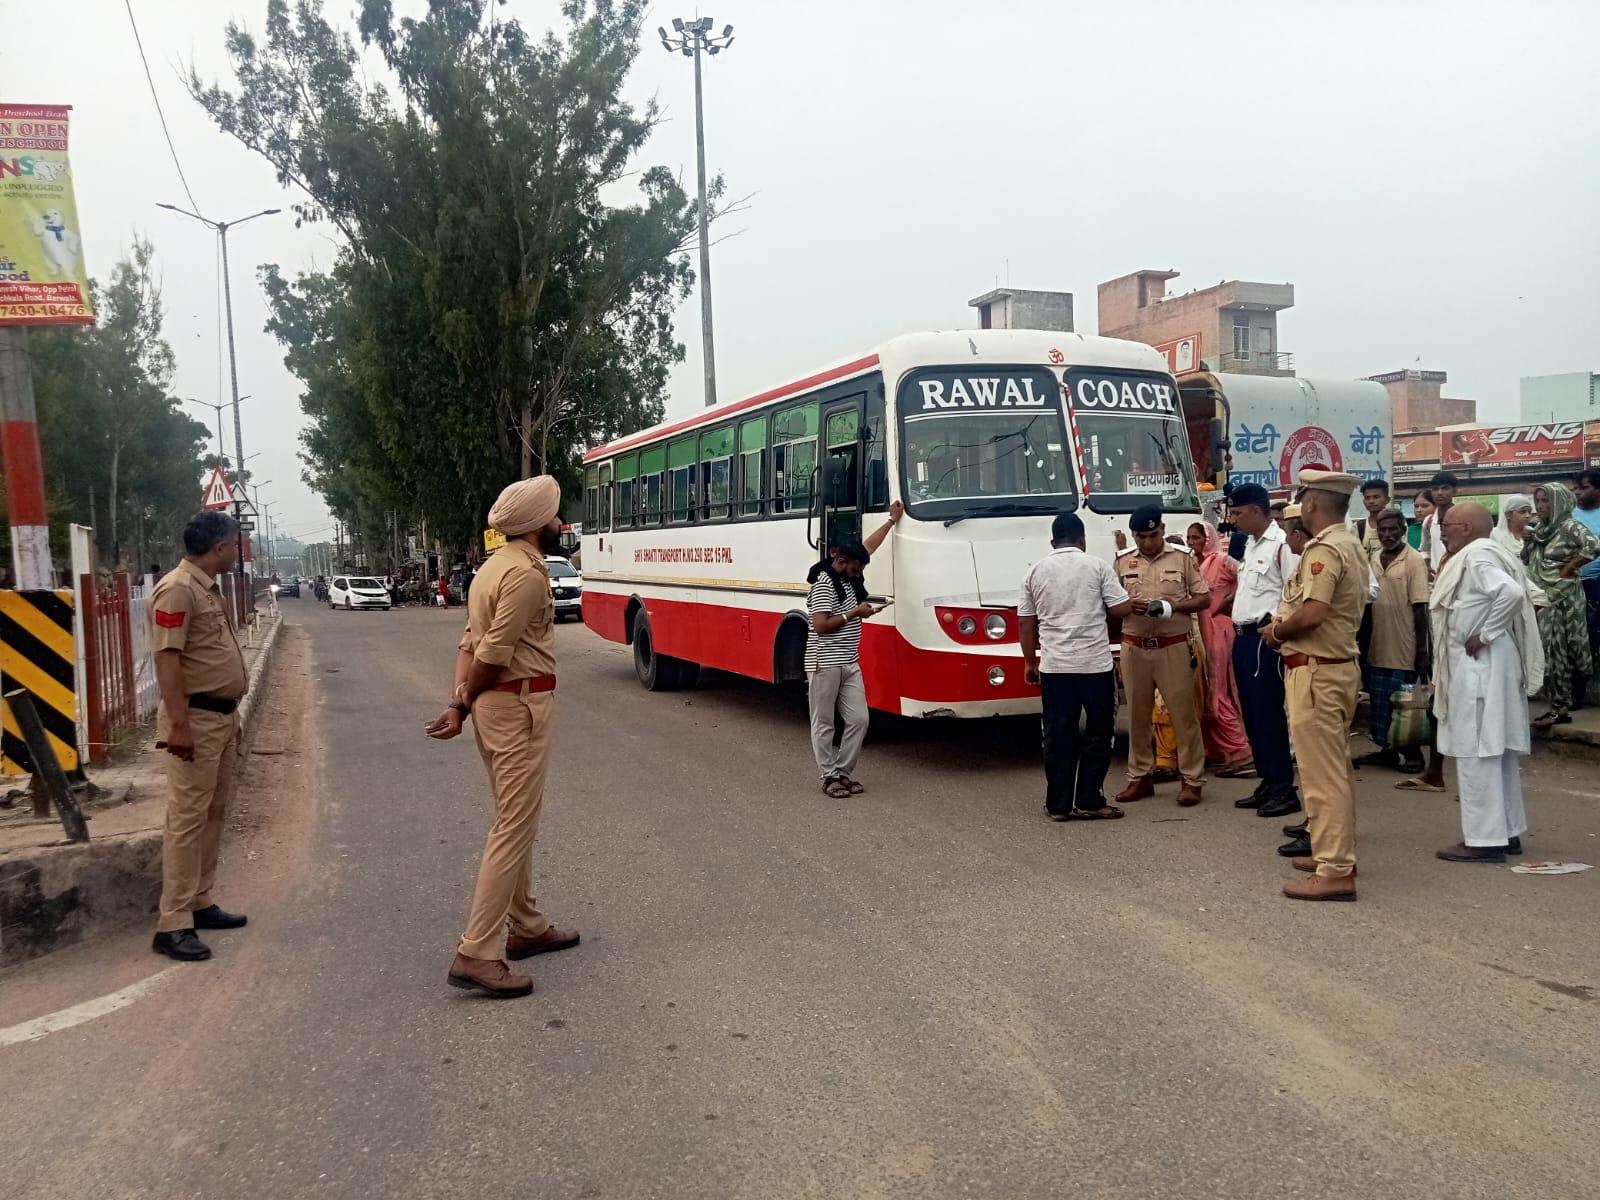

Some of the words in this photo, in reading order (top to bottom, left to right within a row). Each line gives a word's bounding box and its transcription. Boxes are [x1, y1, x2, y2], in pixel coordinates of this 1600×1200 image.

[18, 123, 68, 137] OPEN
[43, 285, 57, 294] Opp
[919, 378, 1045, 410] RAWAL
[1077, 379, 1175, 412] COACH
[1235, 424, 1281, 453] बेटी
[1349, 426, 1384, 454] बेटी
[1488, 422, 1582, 444] STING
[657, 548, 682, 562] TRANSPORT
[704, 546, 714, 563] SEC
[715, 546, 721, 563] 15
